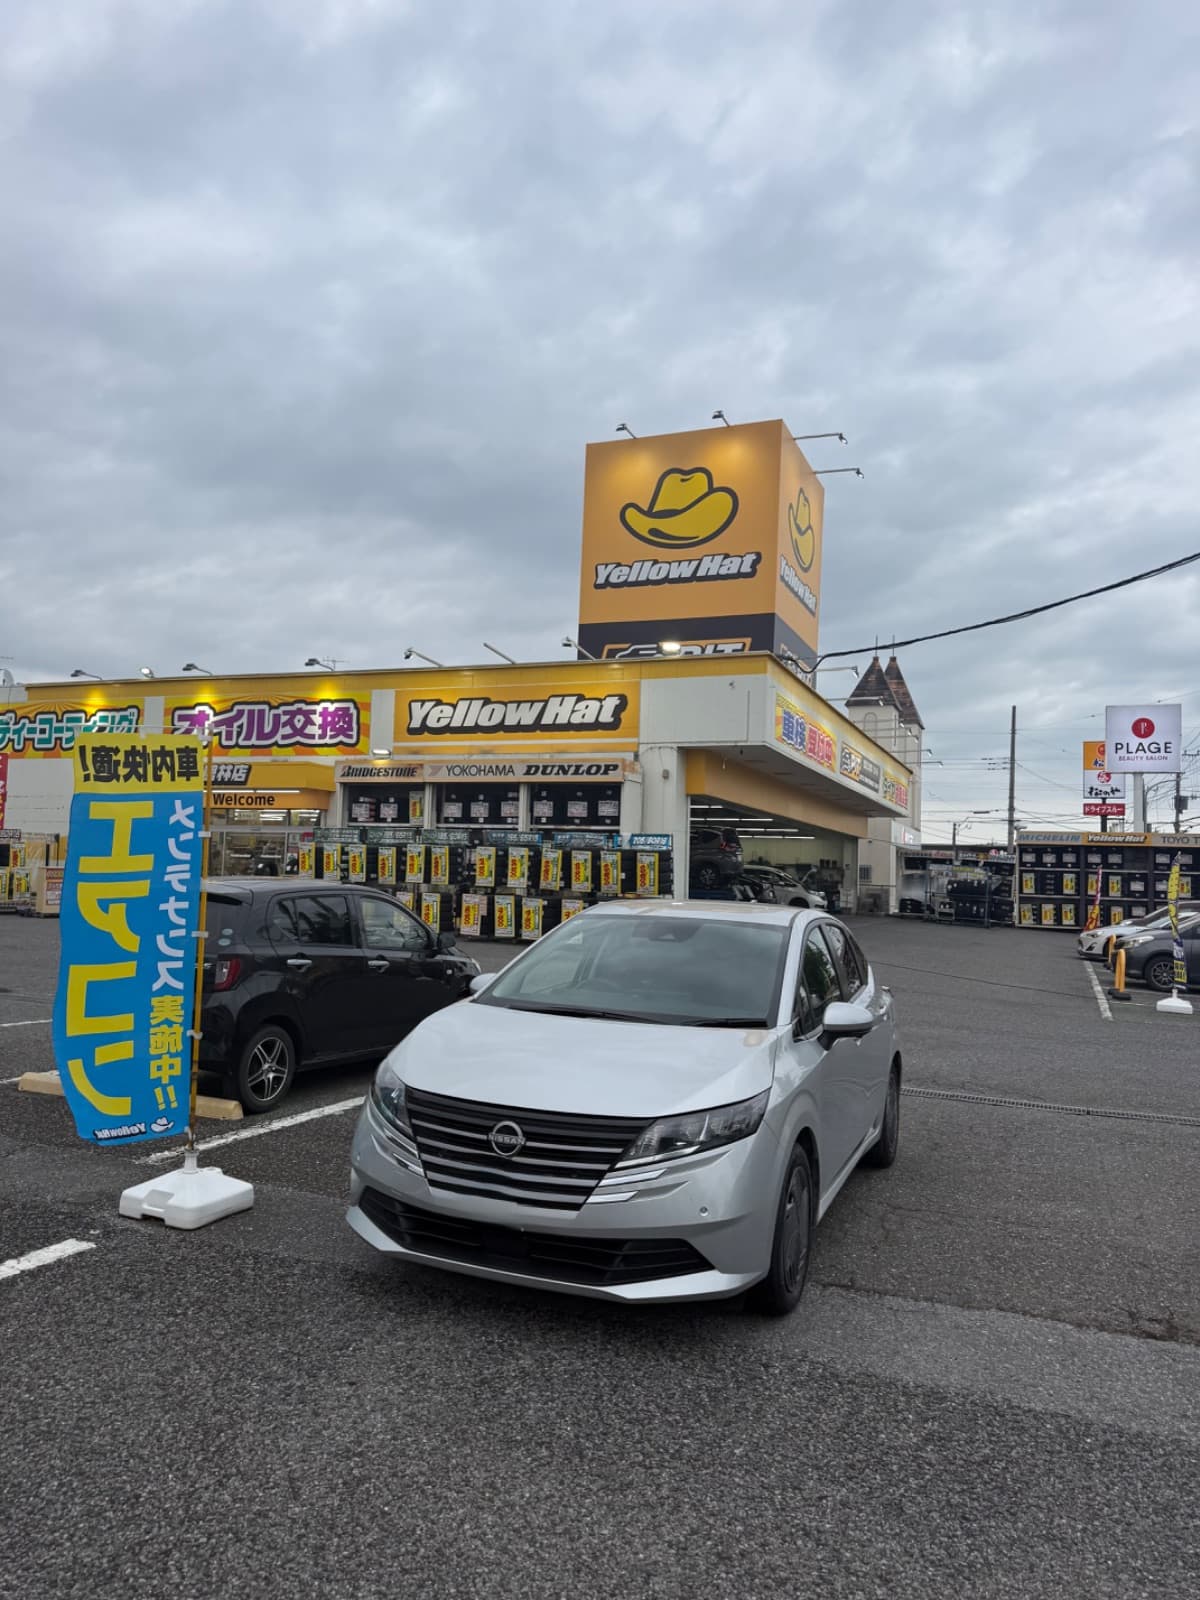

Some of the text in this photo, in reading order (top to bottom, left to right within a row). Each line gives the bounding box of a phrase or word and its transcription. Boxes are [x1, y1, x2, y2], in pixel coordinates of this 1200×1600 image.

[175, 701, 358, 748] オイル交換
[1114, 741, 1173, 755] PLAGE
[339, 765, 418, 778] BRIDGESTONE
[445, 764, 515, 777] YOKOHAMA
[523, 763, 620, 776] DUNLOP
[213, 793, 276, 806] Welcome
[1084, 804, 1124, 814] ドライブスルー
[1018, 834, 1081, 842] MICHELIN
[1162, 836, 1190, 844] TOYO
